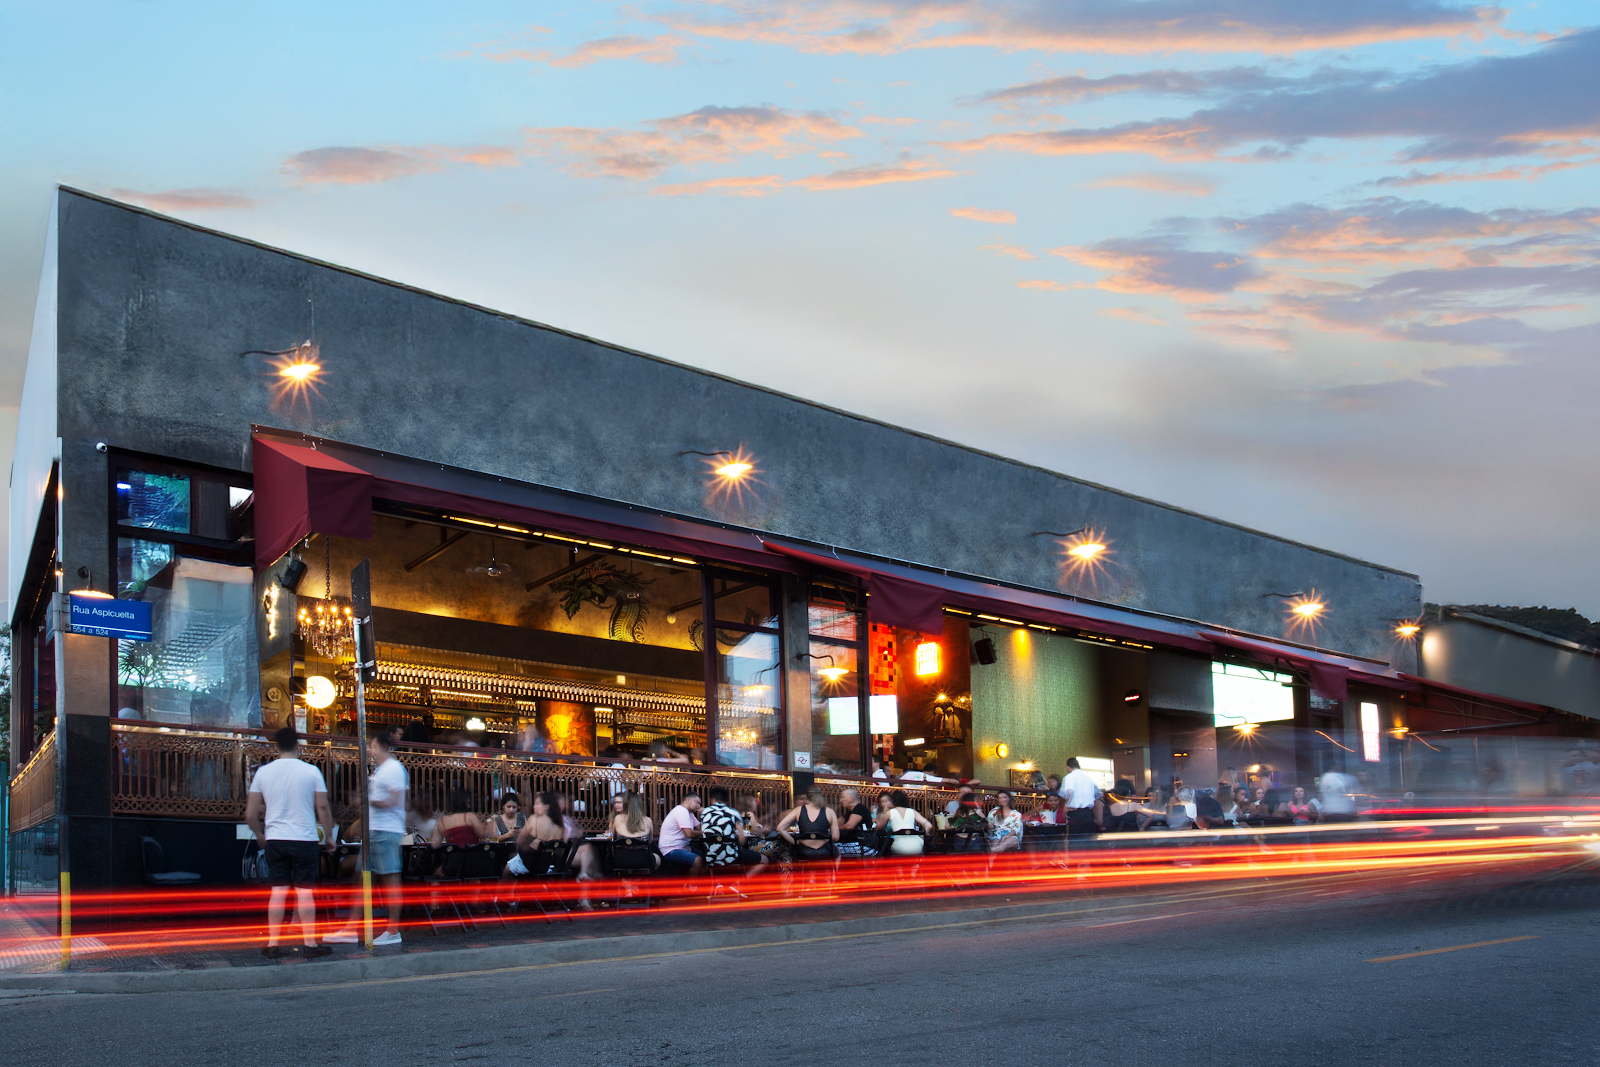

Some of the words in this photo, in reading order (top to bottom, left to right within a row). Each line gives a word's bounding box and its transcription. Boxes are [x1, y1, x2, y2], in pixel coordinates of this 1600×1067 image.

[72, 605, 90, 615] Rua
[91, 607, 135, 619] Aspicuelta
[72, 625, 86, 633] 554
